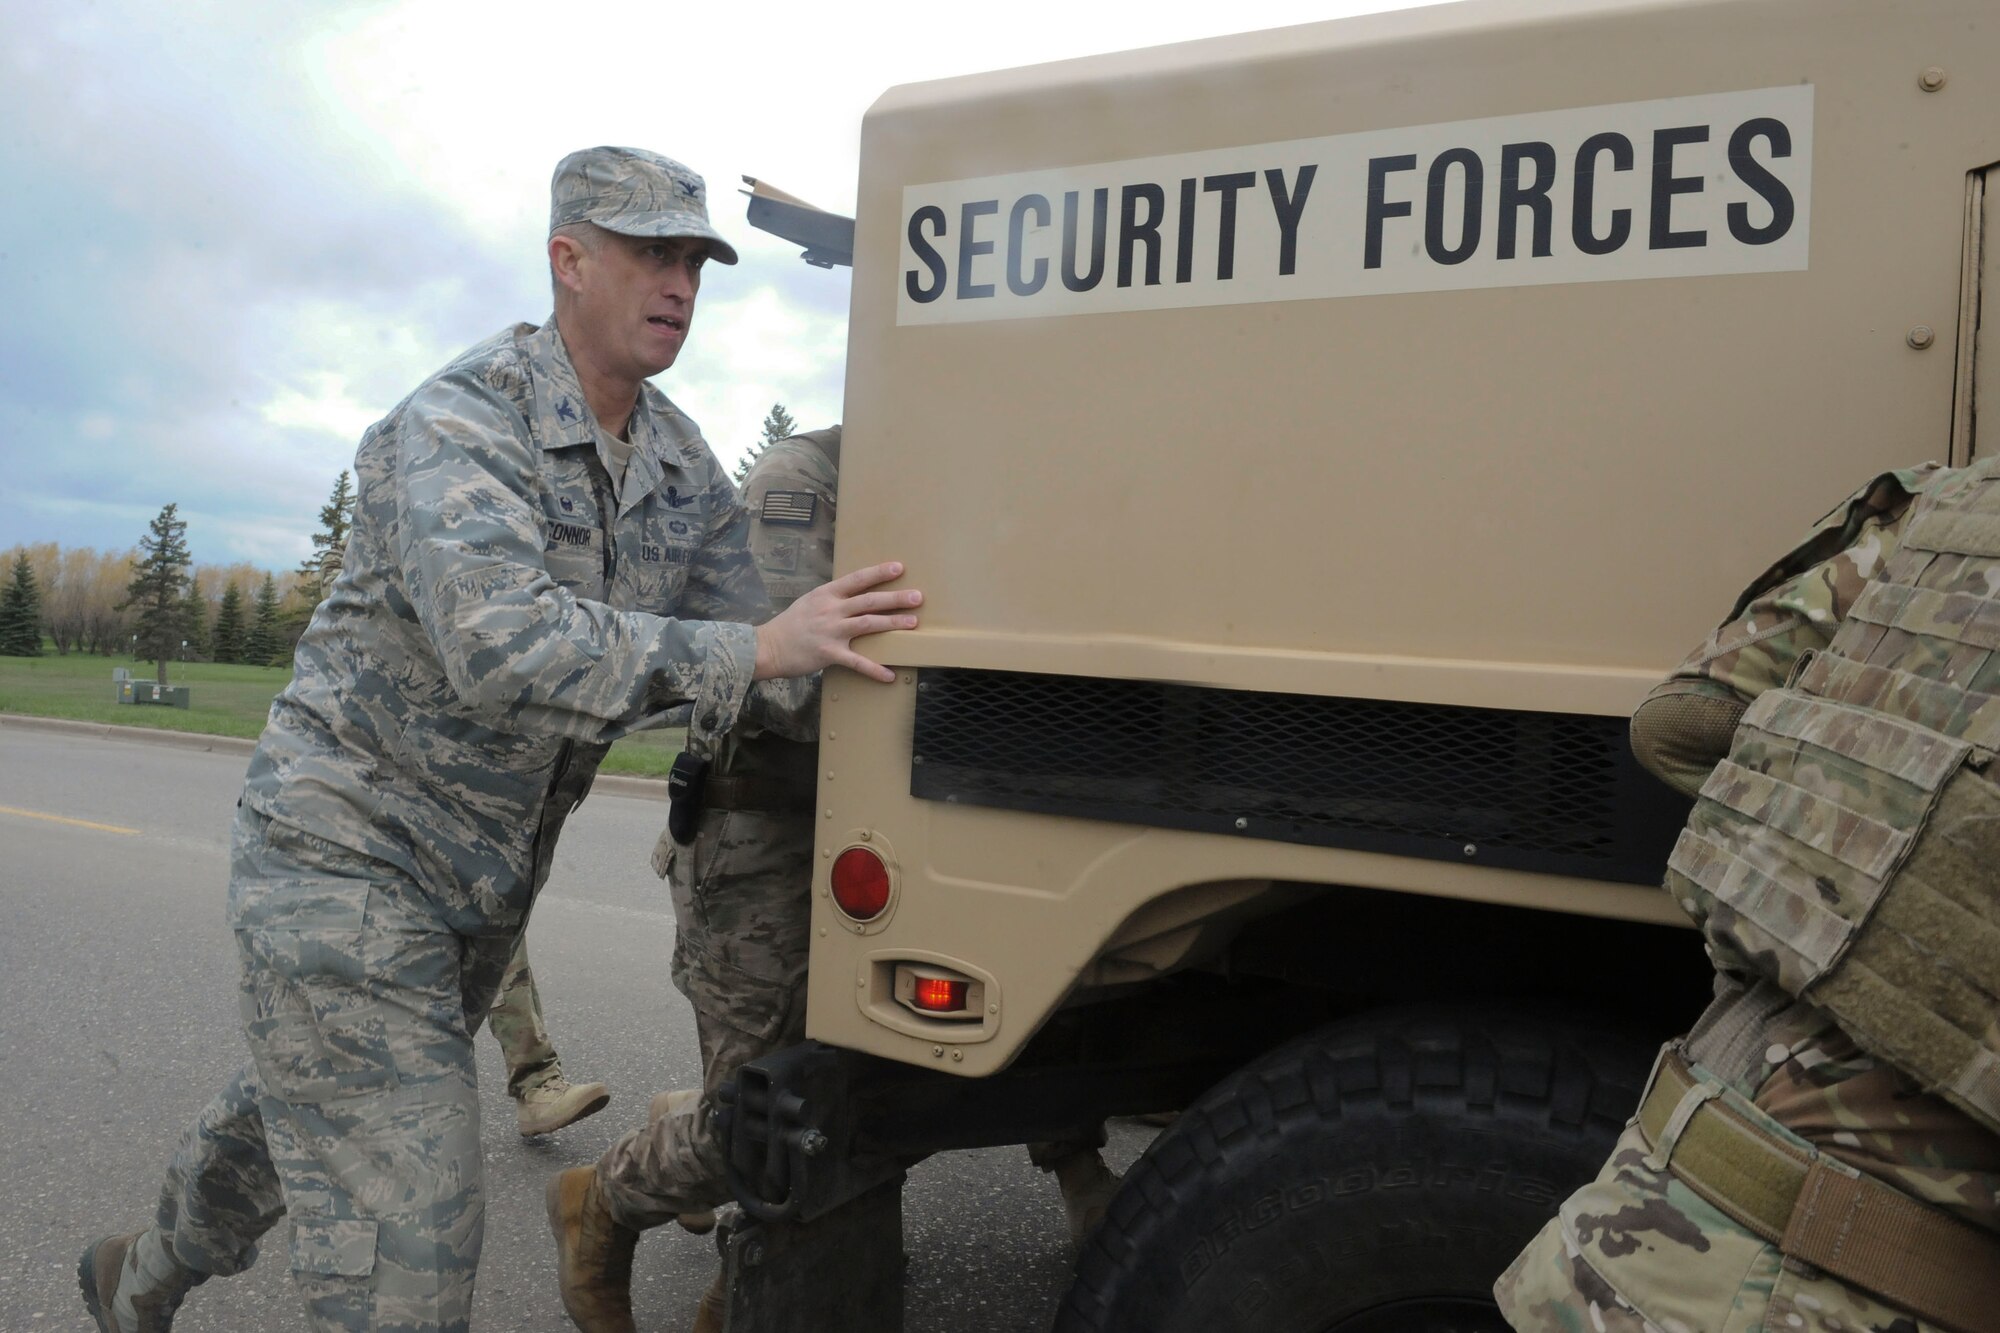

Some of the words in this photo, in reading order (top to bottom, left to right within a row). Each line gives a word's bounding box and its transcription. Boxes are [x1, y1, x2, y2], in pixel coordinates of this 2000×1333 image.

[906, 163, 1319, 304] SECURITY
[1363, 117, 1796, 269] FORCES
[664, 547, 681, 563] AIR
